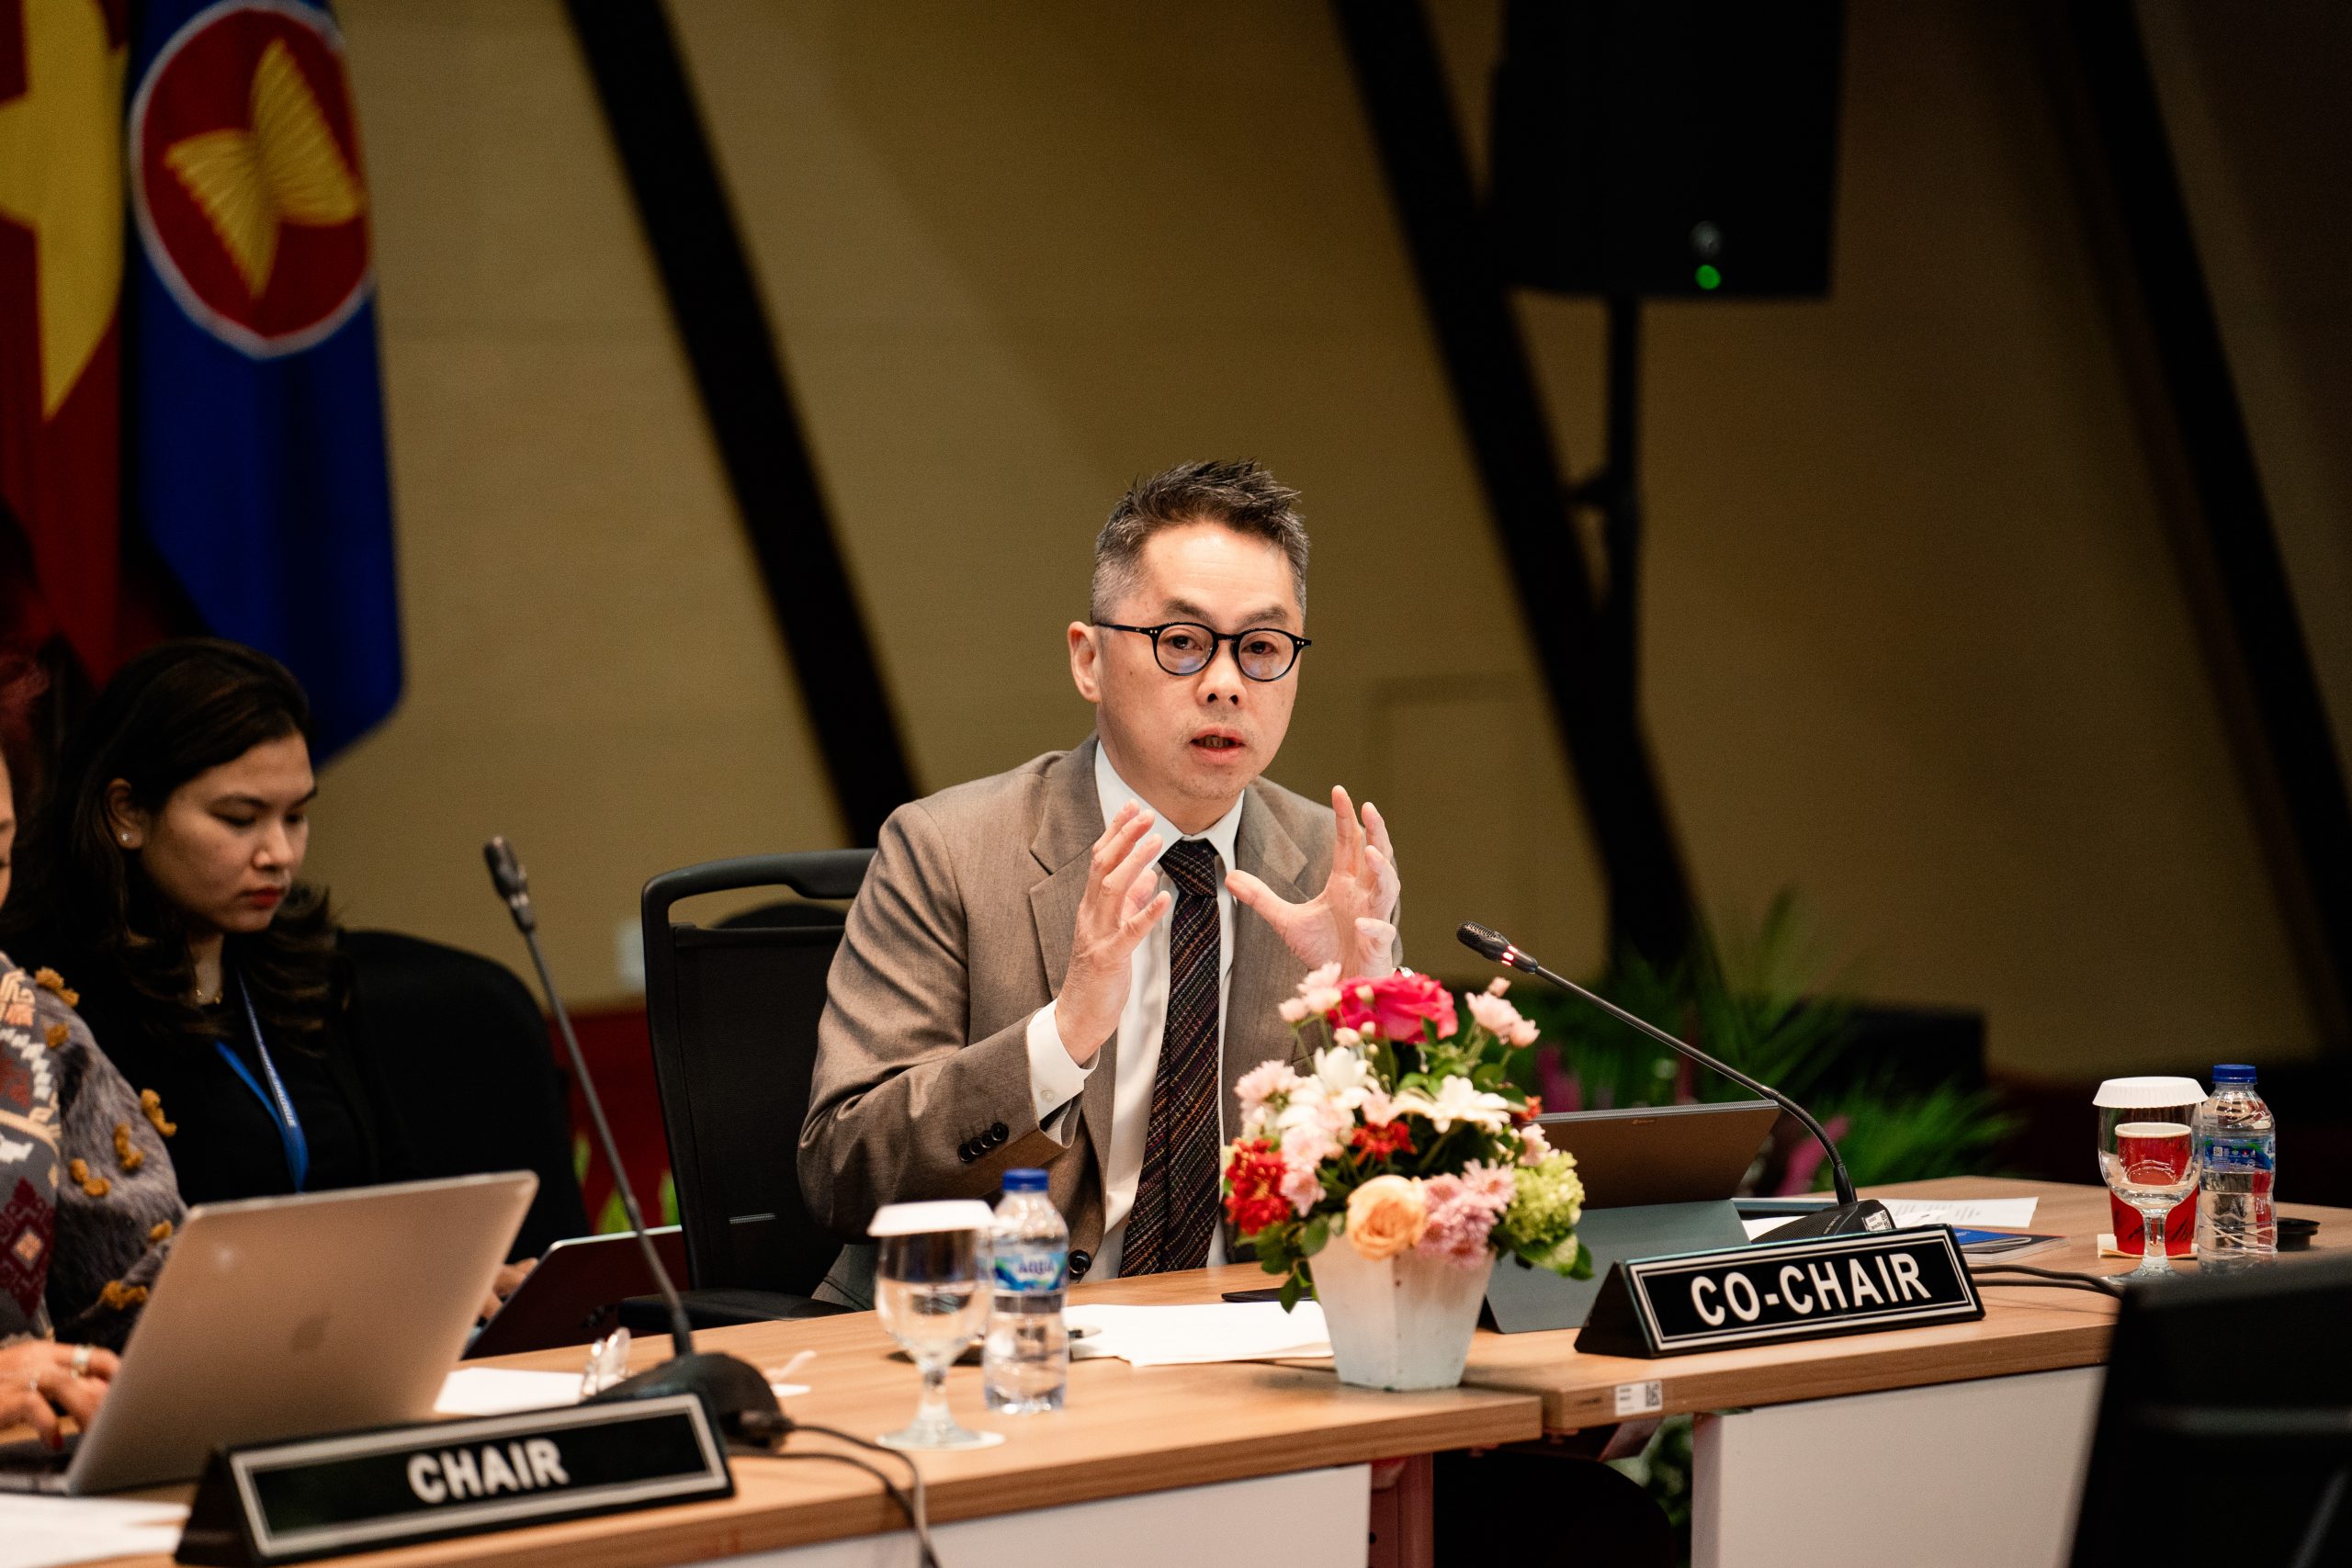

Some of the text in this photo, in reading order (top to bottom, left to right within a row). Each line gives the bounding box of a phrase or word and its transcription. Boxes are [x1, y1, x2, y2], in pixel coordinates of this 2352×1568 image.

[1018, 1260, 1055, 1275] AQUA
[1690, 1252, 1933, 1327] CO-CHAIR
[406, 1438, 571, 1505] CHAIR
